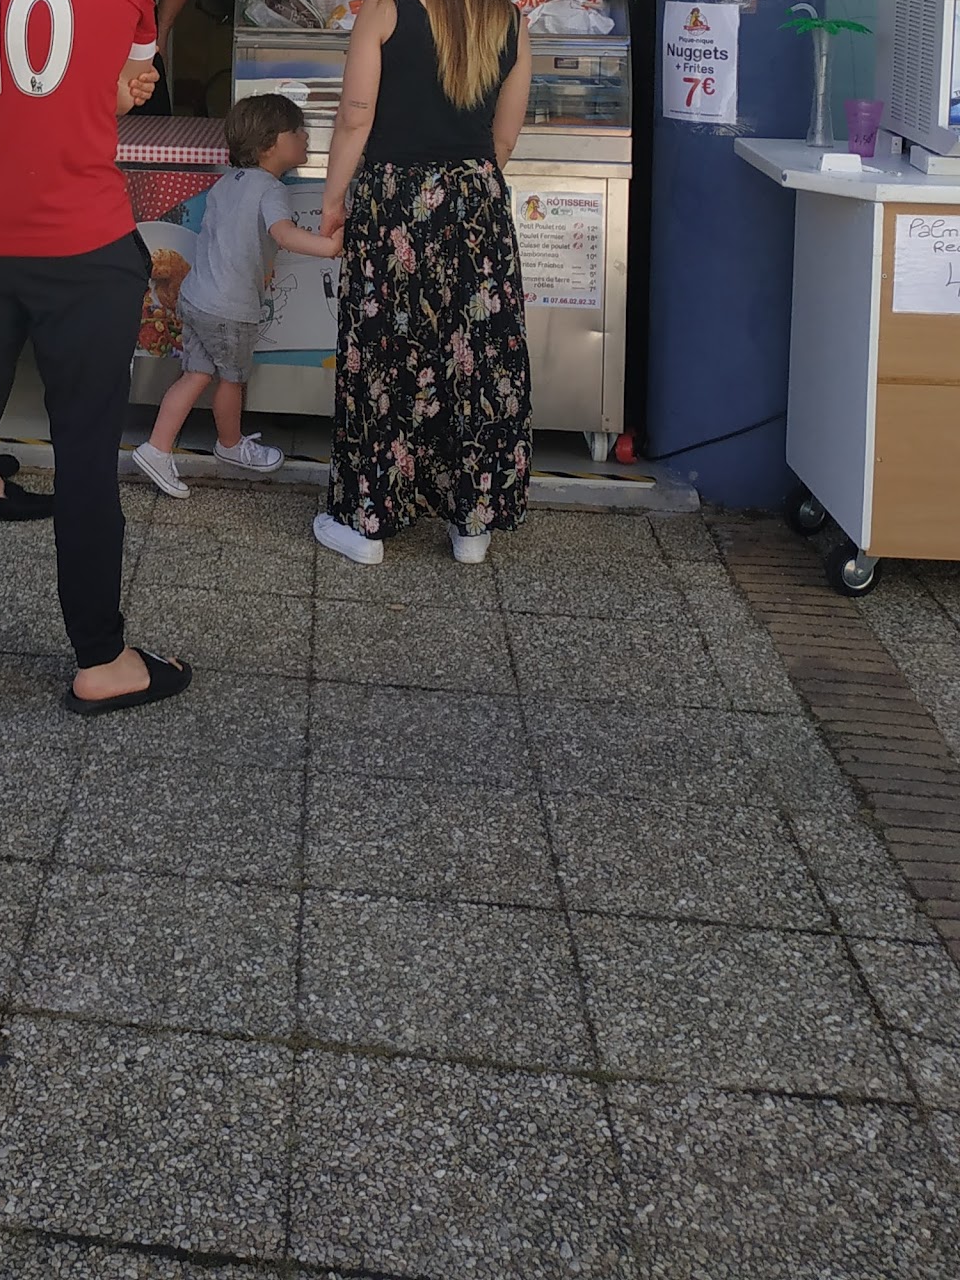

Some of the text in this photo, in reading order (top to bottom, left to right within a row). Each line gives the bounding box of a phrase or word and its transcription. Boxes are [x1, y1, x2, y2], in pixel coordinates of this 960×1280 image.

[679, 36, 714, 45] Pique-nique
[667, 42, 729, 63] Nuggets
[683, 62, 714, 74] Frites
[682, 77, 715, 108] 7€
[546, 197, 598, 207] RÔTISSERIE
[909, 218, 959, 238] Palm
